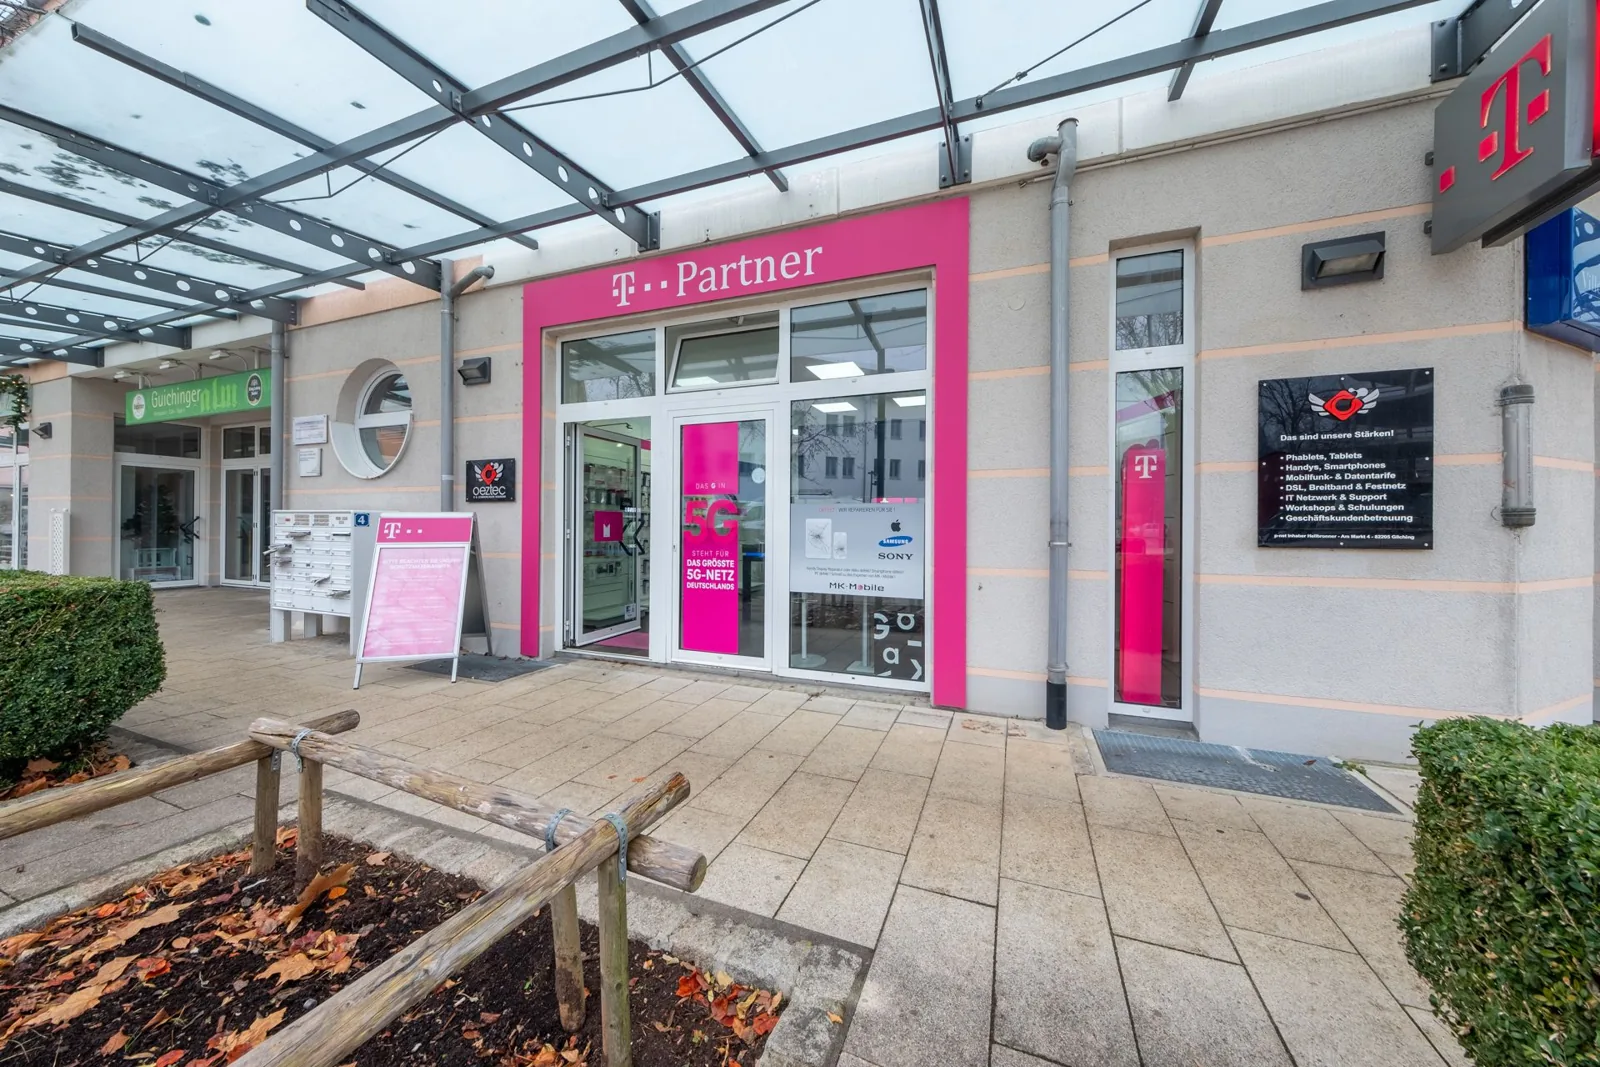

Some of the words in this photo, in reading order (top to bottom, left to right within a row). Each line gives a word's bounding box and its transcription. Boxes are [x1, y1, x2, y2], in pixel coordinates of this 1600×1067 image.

[612, 271, 635, 307] T
[676, 246, 823, 297] Partner
[151, 386, 200, 408] Guichinger
[1299, 433, 1319, 441] sind
[1354, 430, 1394, 438] Stärken!
[1329, 452, 1362, 460] Tablets
[1134, 455, 1157, 478] T
[1286, 464, 1322, 472] Handys,
[1324, 462, 1386, 470] Smartphones
[1344, 472, 1396, 480] Datentarife
[472, 485, 506, 496] oeztec
[1286, 484, 1307, 492] DSL,
[1309, 483, 1353, 491] Breitband
[1365, 482, 1406, 490] Festnetz
[1349, 493, 1387, 502] Support
[1286, 504, 1336, 513] Workshops
[1348, 503, 1404, 512] Schulungen
[358, 515, 366, 525] 4
[684, 499, 738, 542] 5G
[1286, 514, 1413, 523] Geschäftskundenbetreuung
[384, 522, 401, 539] T
[715, 549, 729, 557] FÜR
[687, 559, 701, 567] DAS
[702, 558, 734, 568] GRÖSSTE
[687, 569, 734, 581] 5G-NETZ
[687, 582, 734, 590] DEUTSCHLANDS
